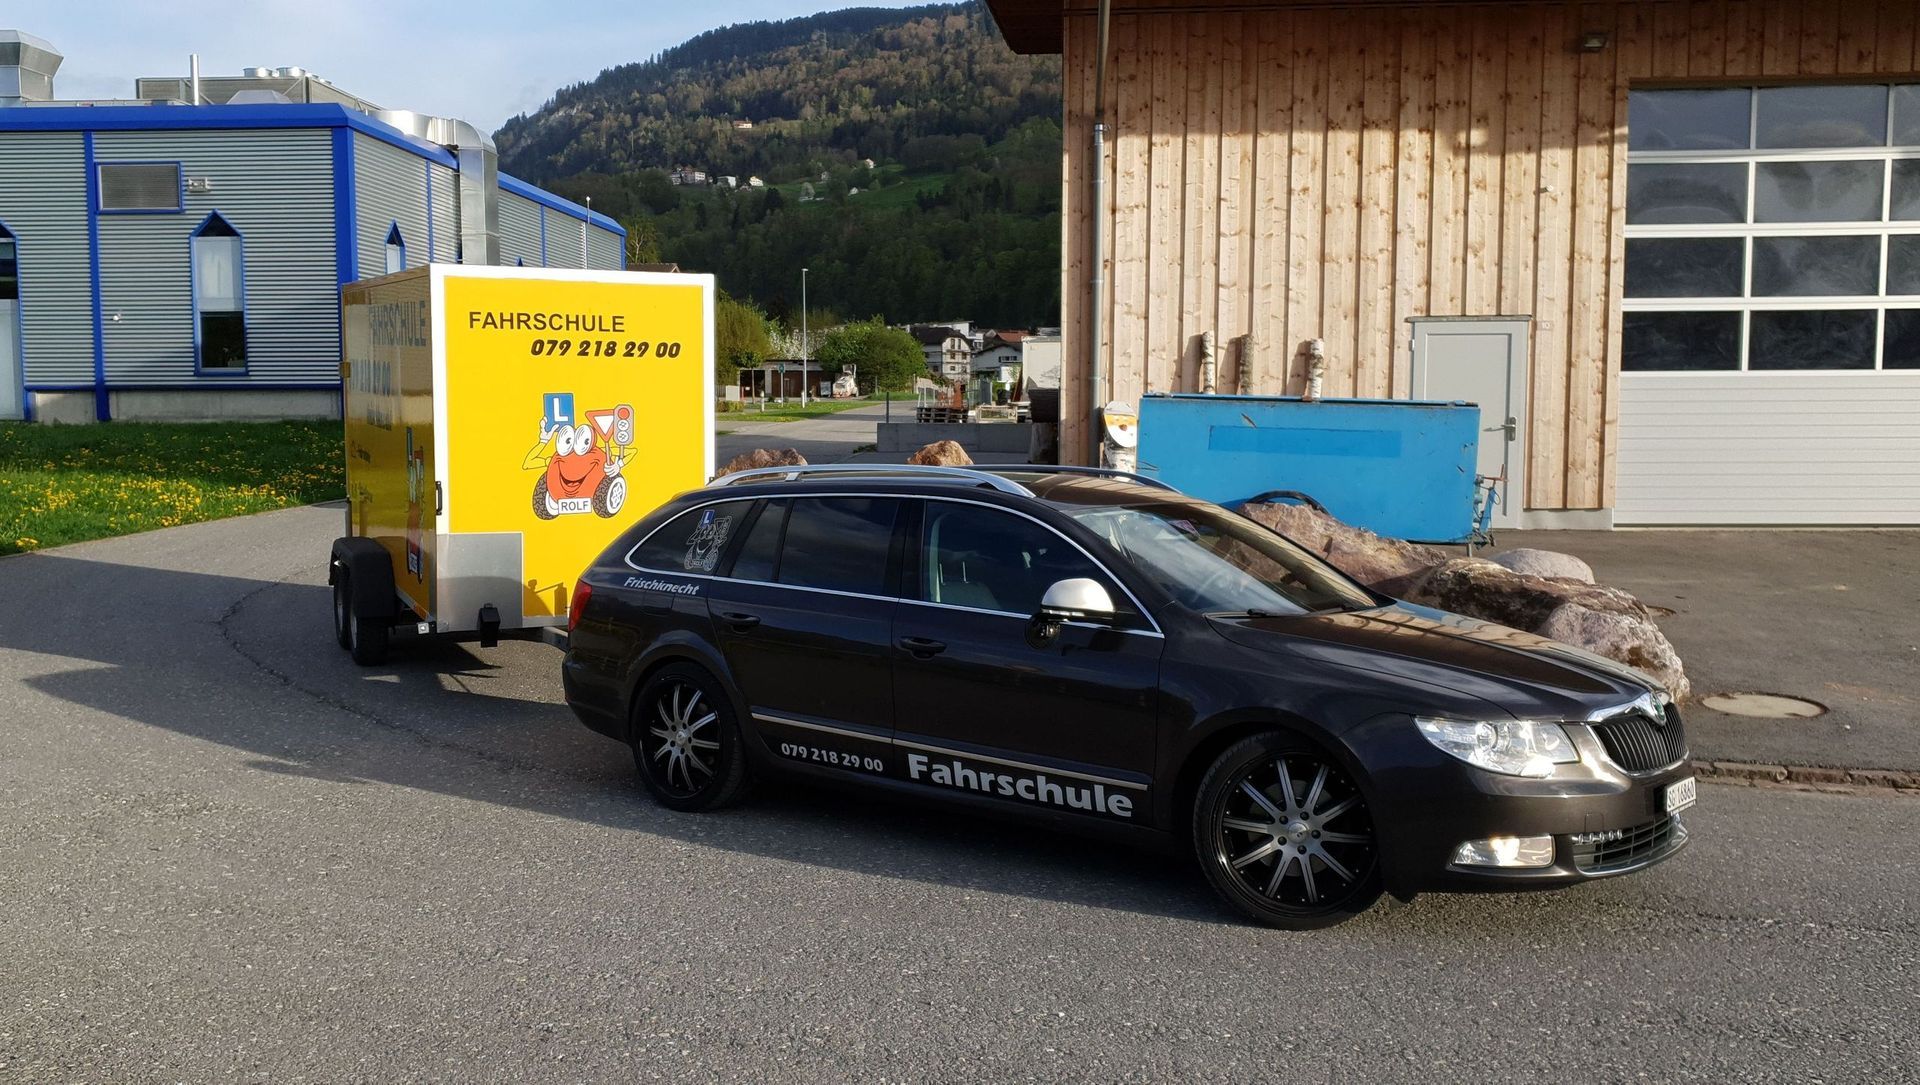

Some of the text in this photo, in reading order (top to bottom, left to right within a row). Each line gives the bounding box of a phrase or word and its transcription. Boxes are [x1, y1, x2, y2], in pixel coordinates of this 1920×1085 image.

[469, 311, 625, 333] FAHRSCHULE
[530, 339, 681, 359] 079 218 29 00
[553, 397, 569, 421] L
[561, 501, 589, 512] ROLF
[623, 577, 700, 595] Frischknecht
[781, 743, 883, 772] 079 218 29 00
[907, 753, 1133, 818] Fahrschule
